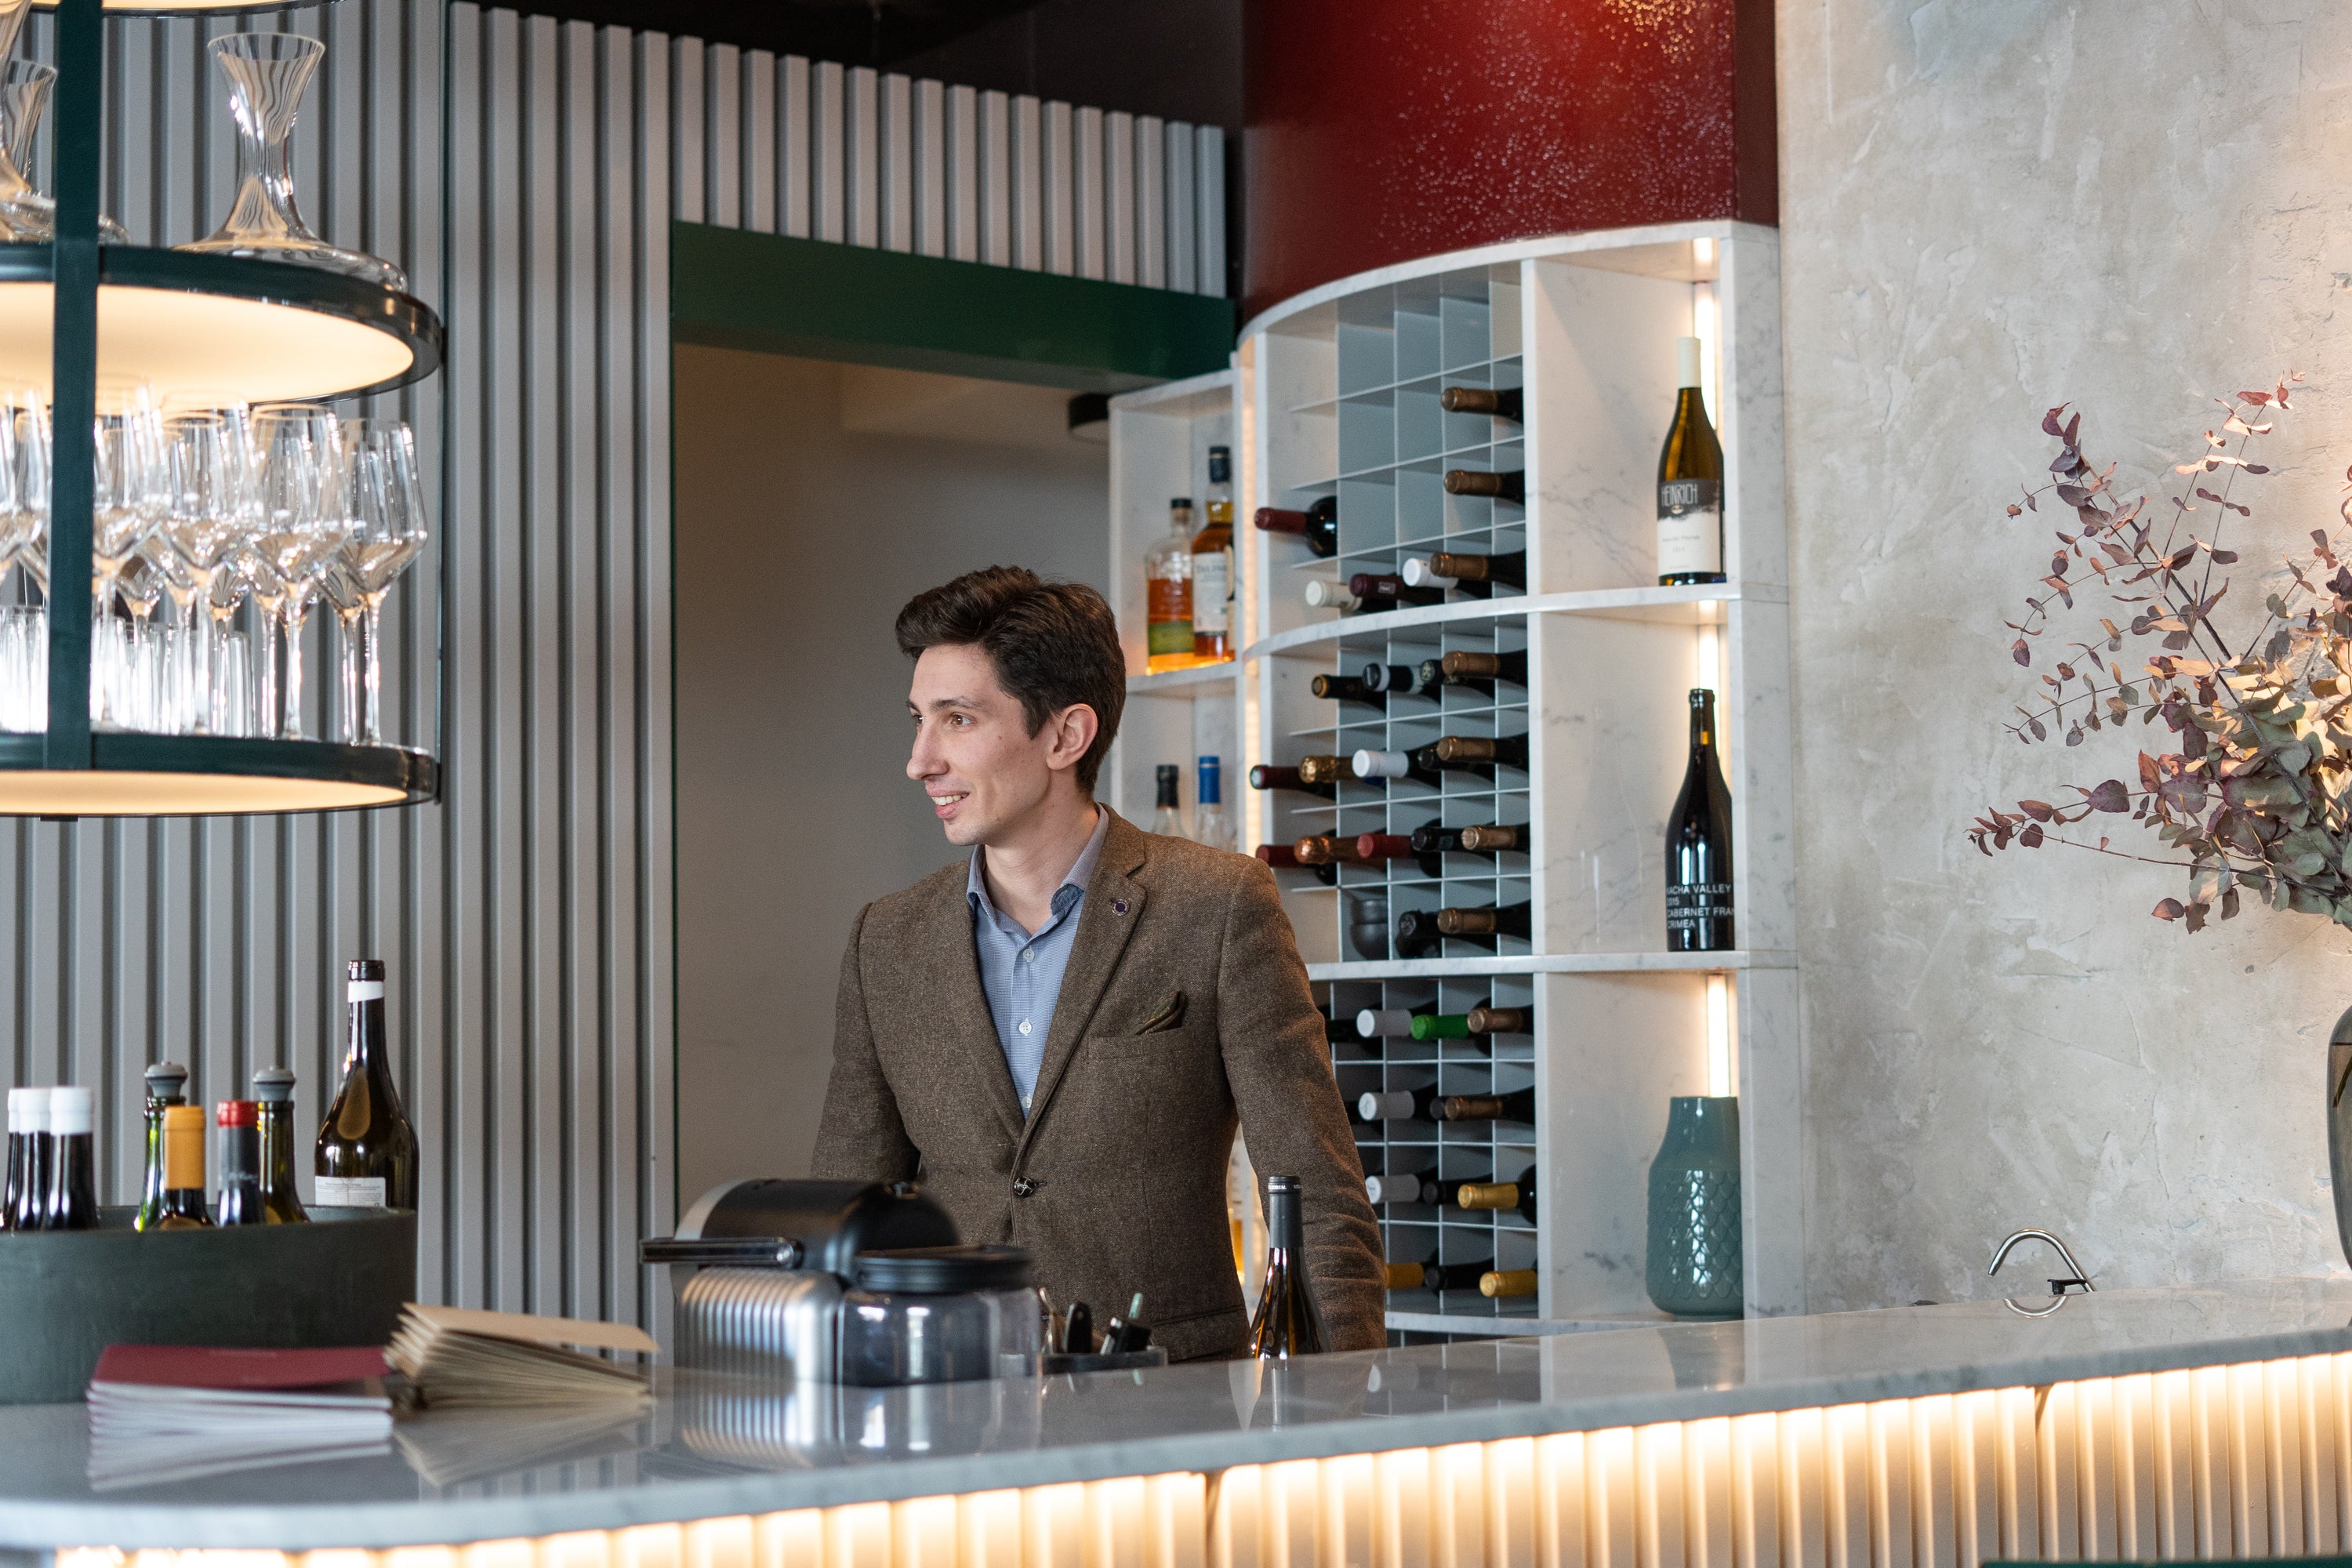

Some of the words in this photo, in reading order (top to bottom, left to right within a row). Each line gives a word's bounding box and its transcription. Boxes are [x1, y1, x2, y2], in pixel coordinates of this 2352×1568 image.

[1662, 483, 1698, 506] HEINRICH
[1693, 884, 1731, 894] VALLEY
[1667, 907, 1710, 918] CABERNET
[1668, 919, 1696, 928] CRIMEA
